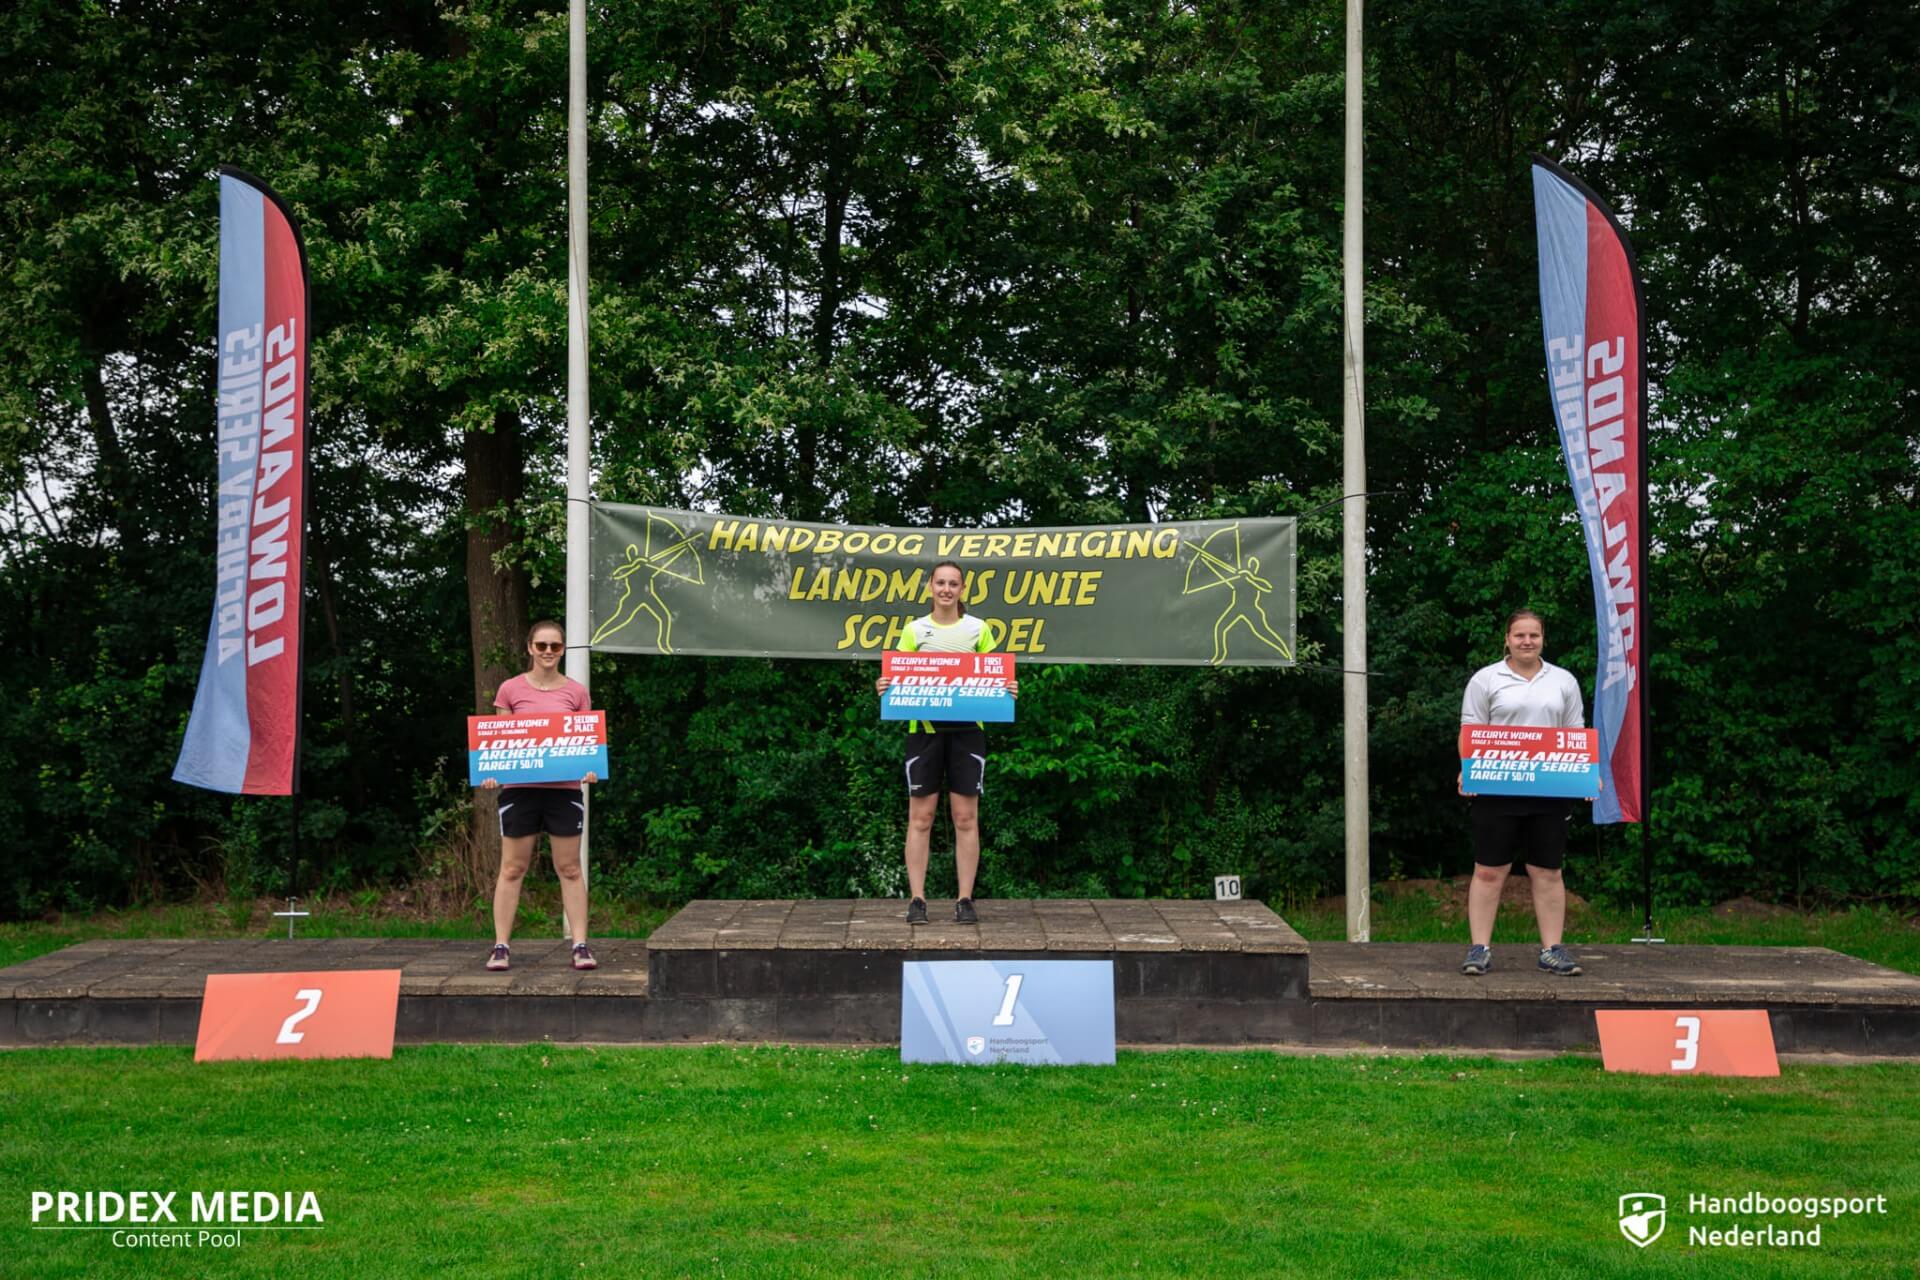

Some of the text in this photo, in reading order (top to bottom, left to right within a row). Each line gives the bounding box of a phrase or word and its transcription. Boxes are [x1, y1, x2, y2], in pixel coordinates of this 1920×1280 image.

[708, 520, 1180, 559] HANDBOOG VERENIGING
[1003, 569, 1103, 607] UNIE
[890, 656, 961, 666] RECURVE WOMEN
[974, 656, 981, 674] 1
[984, 656, 1003, 665] FIRST
[984, 665, 1004, 674] PLACE
[890, 675, 1008, 687] LOWLANDS
[890, 686, 1008, 698] ARCHERY SERIES
[889, 696, 953, 707] TARGET 50/70
[477, 719, 550, 730] RECURVE WOMEN
[563, 715, 572, 733] 2
[574, 715, 599, 724] SECOND
[574, 723, 595, 732] PLACE
[1471, 730, 1543, 741] RECURVE WOMEN
[1556, 731, 1565, 749] 3
[1567, 732, 1587, 741] THIRD
[478, 735, 598, 750] LOWLANDS
[1567, 740, 1587, 750] PLACE
[478, 745, 599, 760] ARCHERY SERIES
[1470, 749, 1592, 763] LOWLANDS
[478, 759, 544, 772] TARGET 50/70
[1471, 760, 1592, 773] ARCHERY SERIES
[1470, 770, 1536, 782] TARGET 50/70
[1217, 879, 1240, 897] 10
[992, 974, 1024, 1026] 1
[275, 989, 322, 1044] 2
[1670, 1017, 1700, 1071] 3
